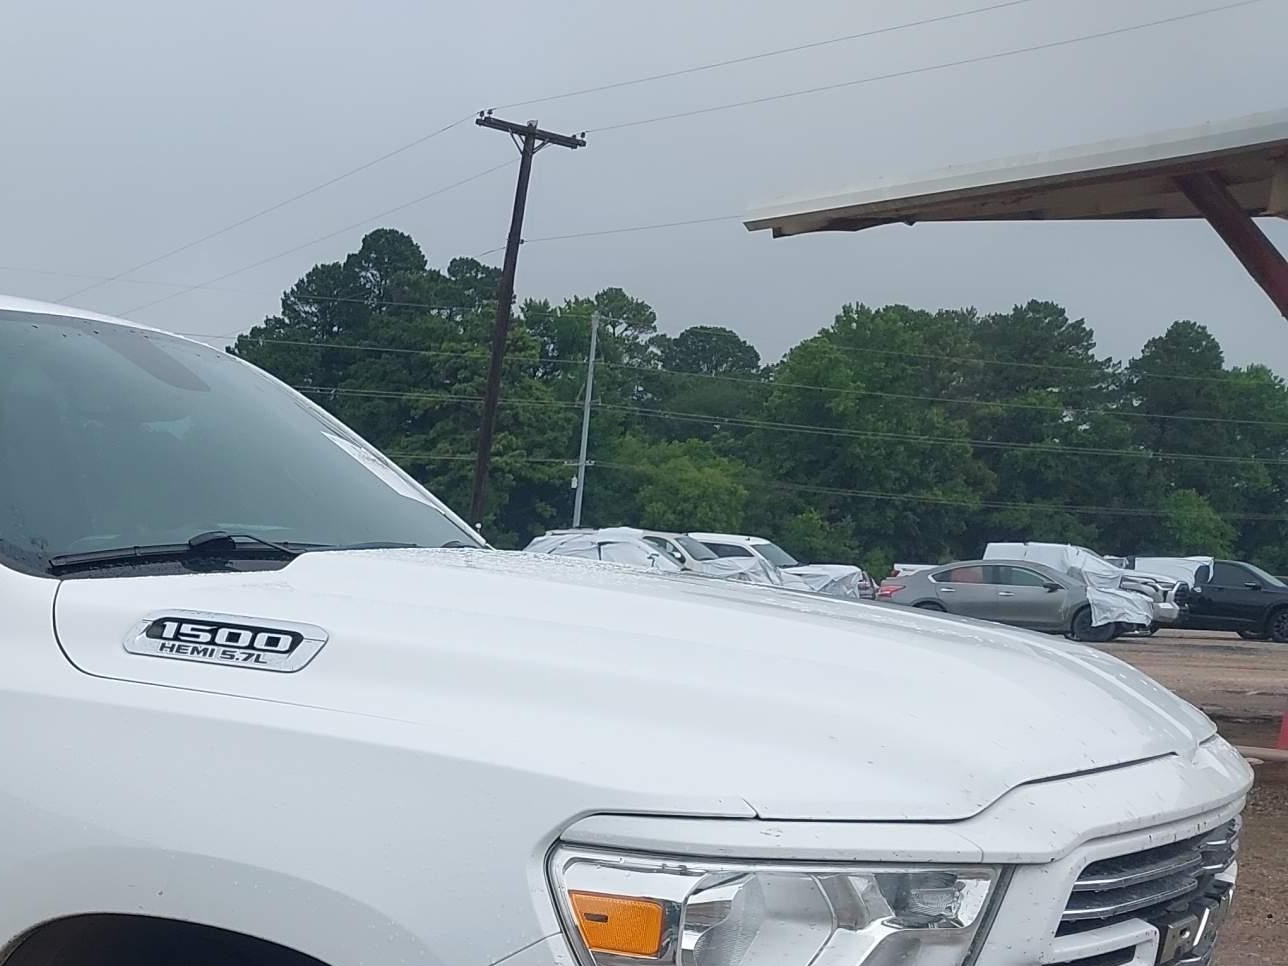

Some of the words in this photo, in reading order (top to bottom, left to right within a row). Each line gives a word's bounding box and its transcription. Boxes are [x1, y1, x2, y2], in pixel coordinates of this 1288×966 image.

[161, 621, 293, 651] 1500
[159, 641, 214, 658] HEMI
[220, 650, 268, 664] 5.7L
